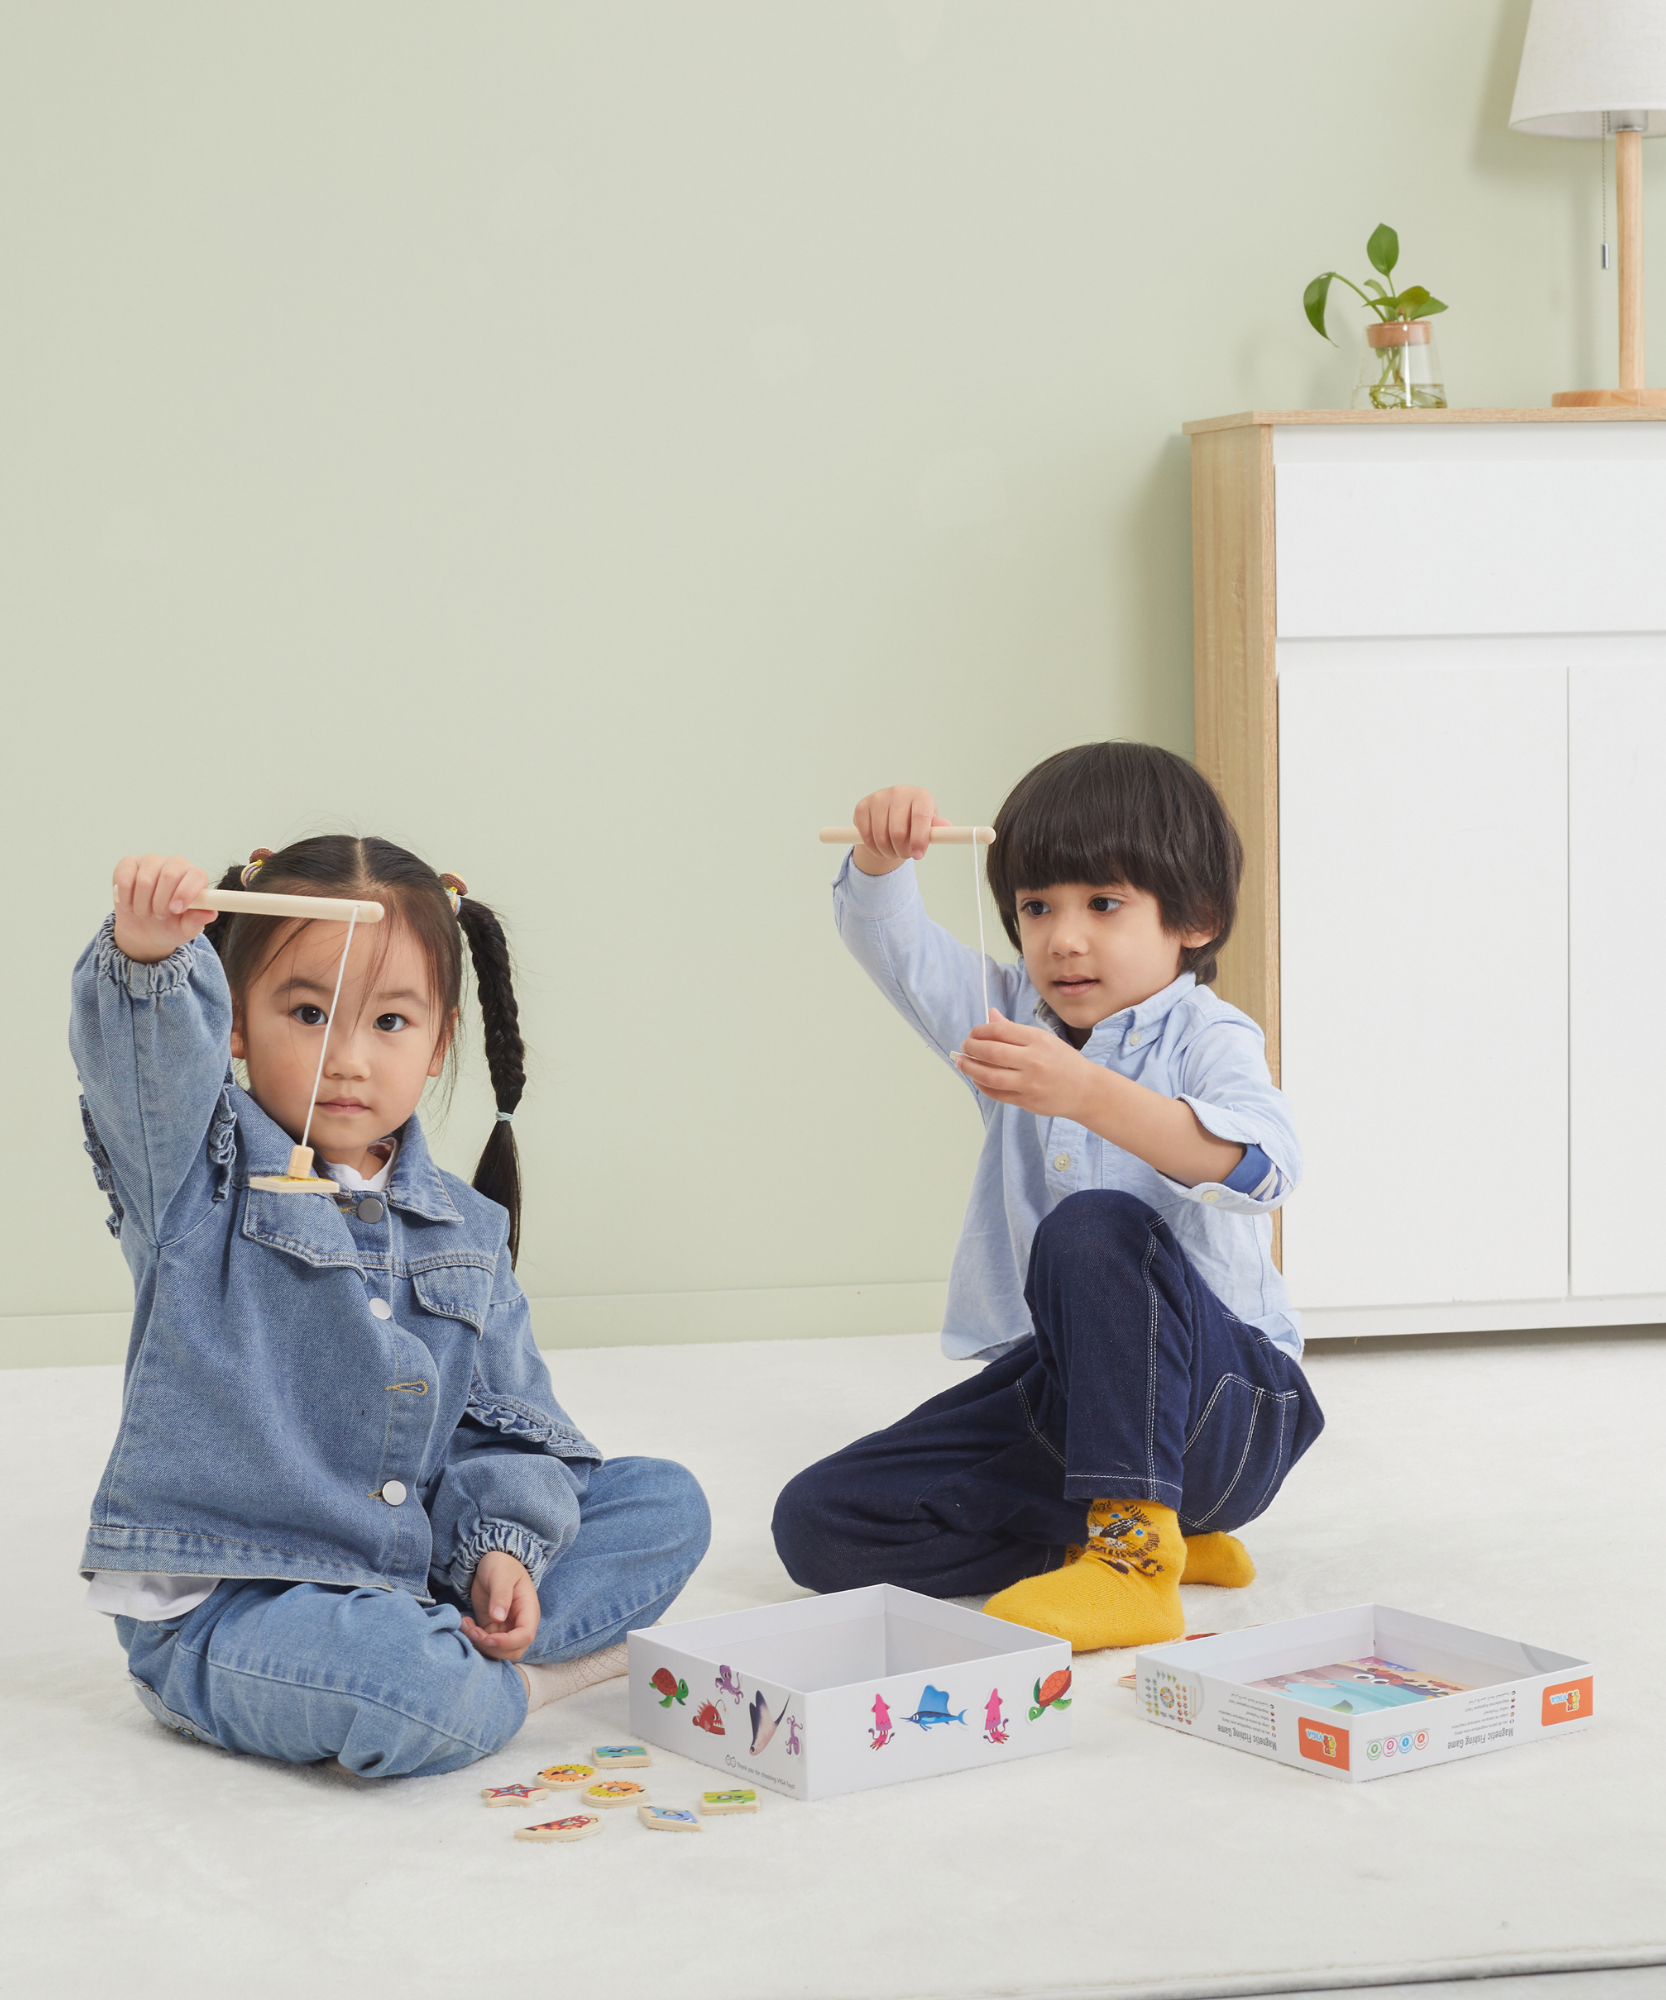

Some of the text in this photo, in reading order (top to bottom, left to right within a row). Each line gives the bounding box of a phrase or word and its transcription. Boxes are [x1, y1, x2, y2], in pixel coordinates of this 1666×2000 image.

[1550, 1694, 1567, 1705] VIGA
[1217, 1724, 1232, 1738] Game
[1233, 1727, 1252, 1743] Fishing
[1307, 1730, 1324, 1741] VIGA
[1487, 1727, 1514, 1741] Magnetic
[1253, 1735, 1277, 1751] Magnetic
[1447, 1739, 1465, 1749] Game
[1465, 1735, 1486, 1745] Fishing
